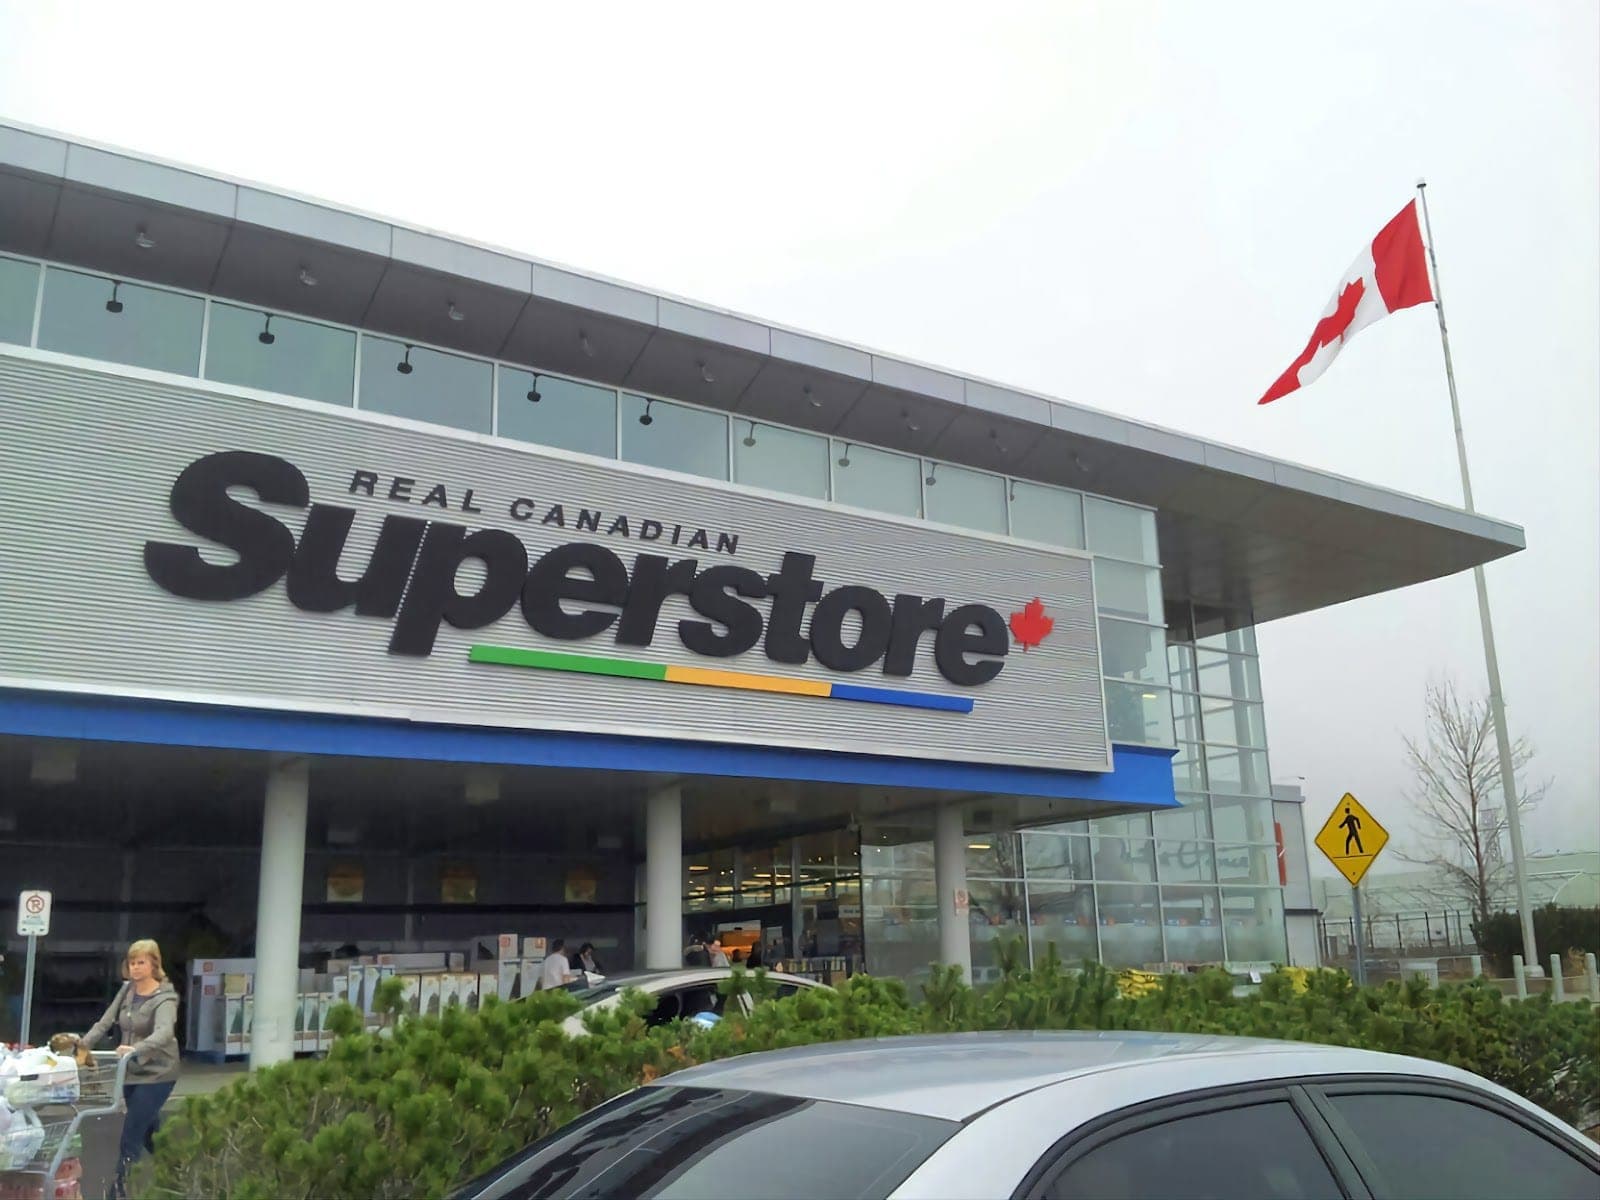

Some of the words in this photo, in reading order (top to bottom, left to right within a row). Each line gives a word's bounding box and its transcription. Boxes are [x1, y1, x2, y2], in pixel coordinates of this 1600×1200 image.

[143, 451, 1010, 687] Superstore
[349, 470, 481, 512] REAL
[509, 497, 739, 555] CANADIAN
